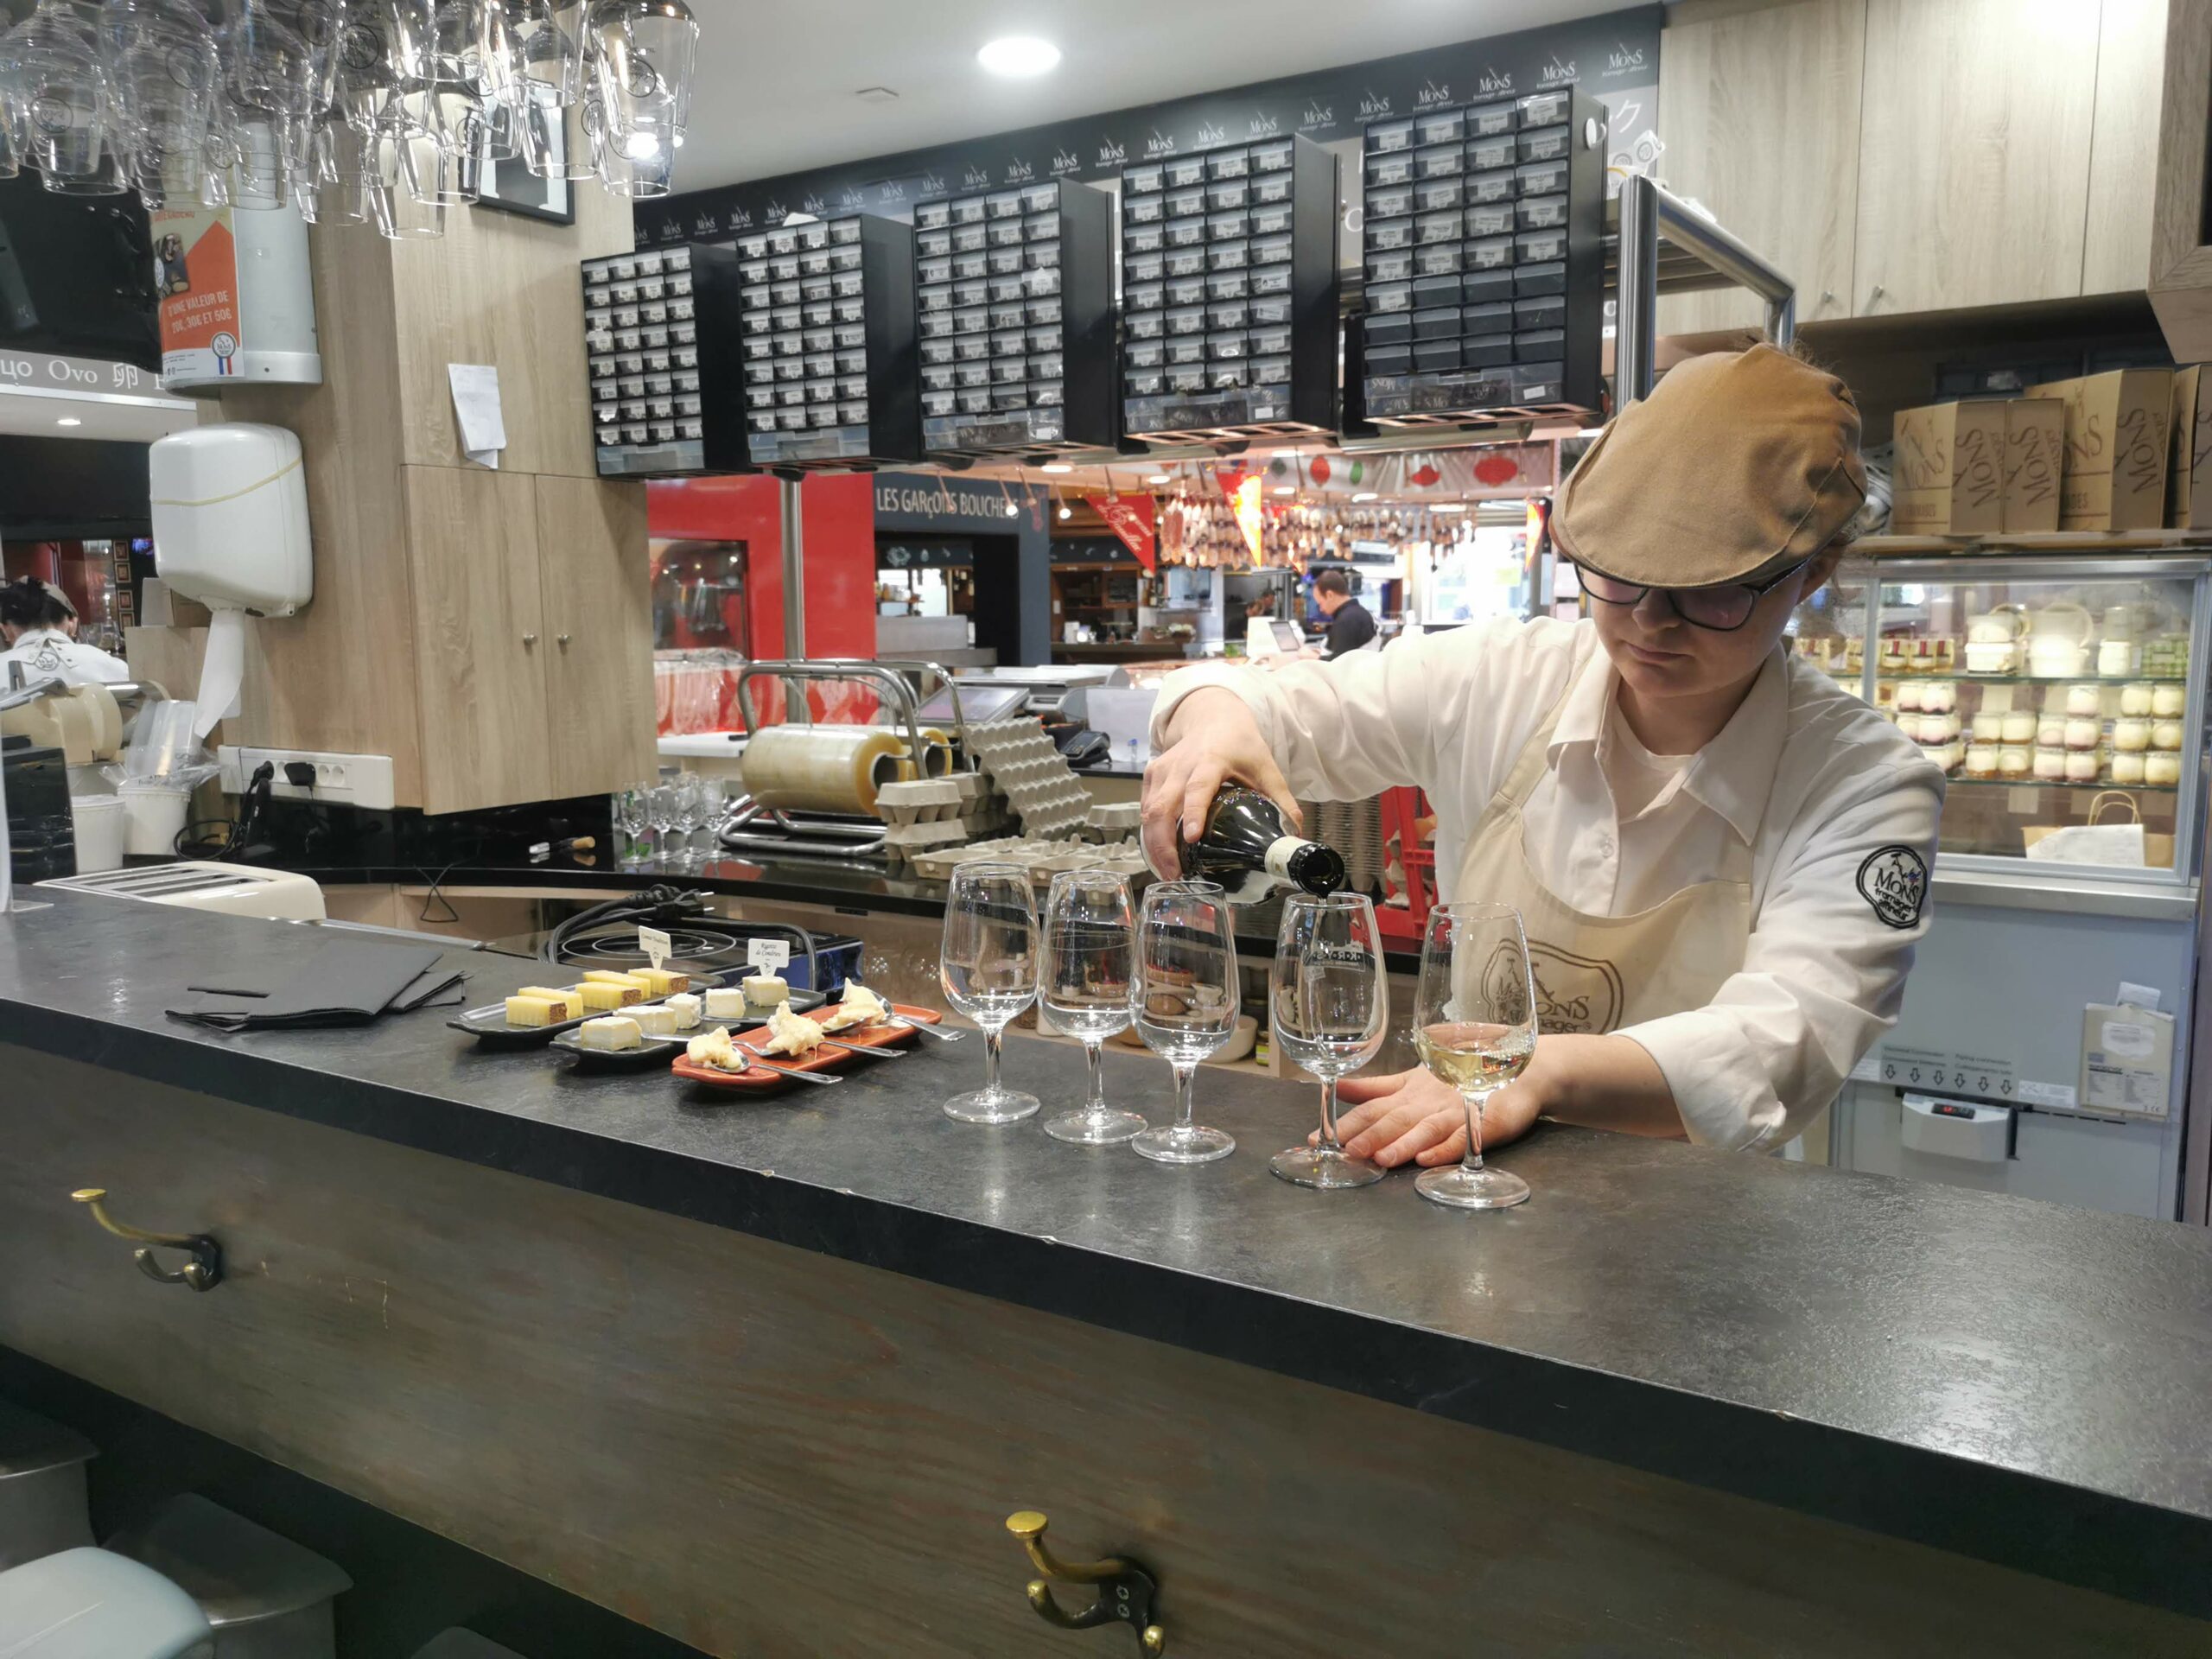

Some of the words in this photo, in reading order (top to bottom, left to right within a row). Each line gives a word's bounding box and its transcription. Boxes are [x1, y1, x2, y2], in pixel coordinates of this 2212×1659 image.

[186, 293, 217, 310] VALEUR
[217, 290, 229, 303] DE
[202, 311, 213, 324] ET
[48, 360, 98, 383] Ovo
[2117, 408, 2162, 493] MONS
[1955, 429, 1999, 508] MONS
[2009, 426, 2056, 507] MONS
[876, 488, 898, 512] LES
[1874, 868, 1919, 904] MONS
[1535, 995, 1590, 1020] ONS
